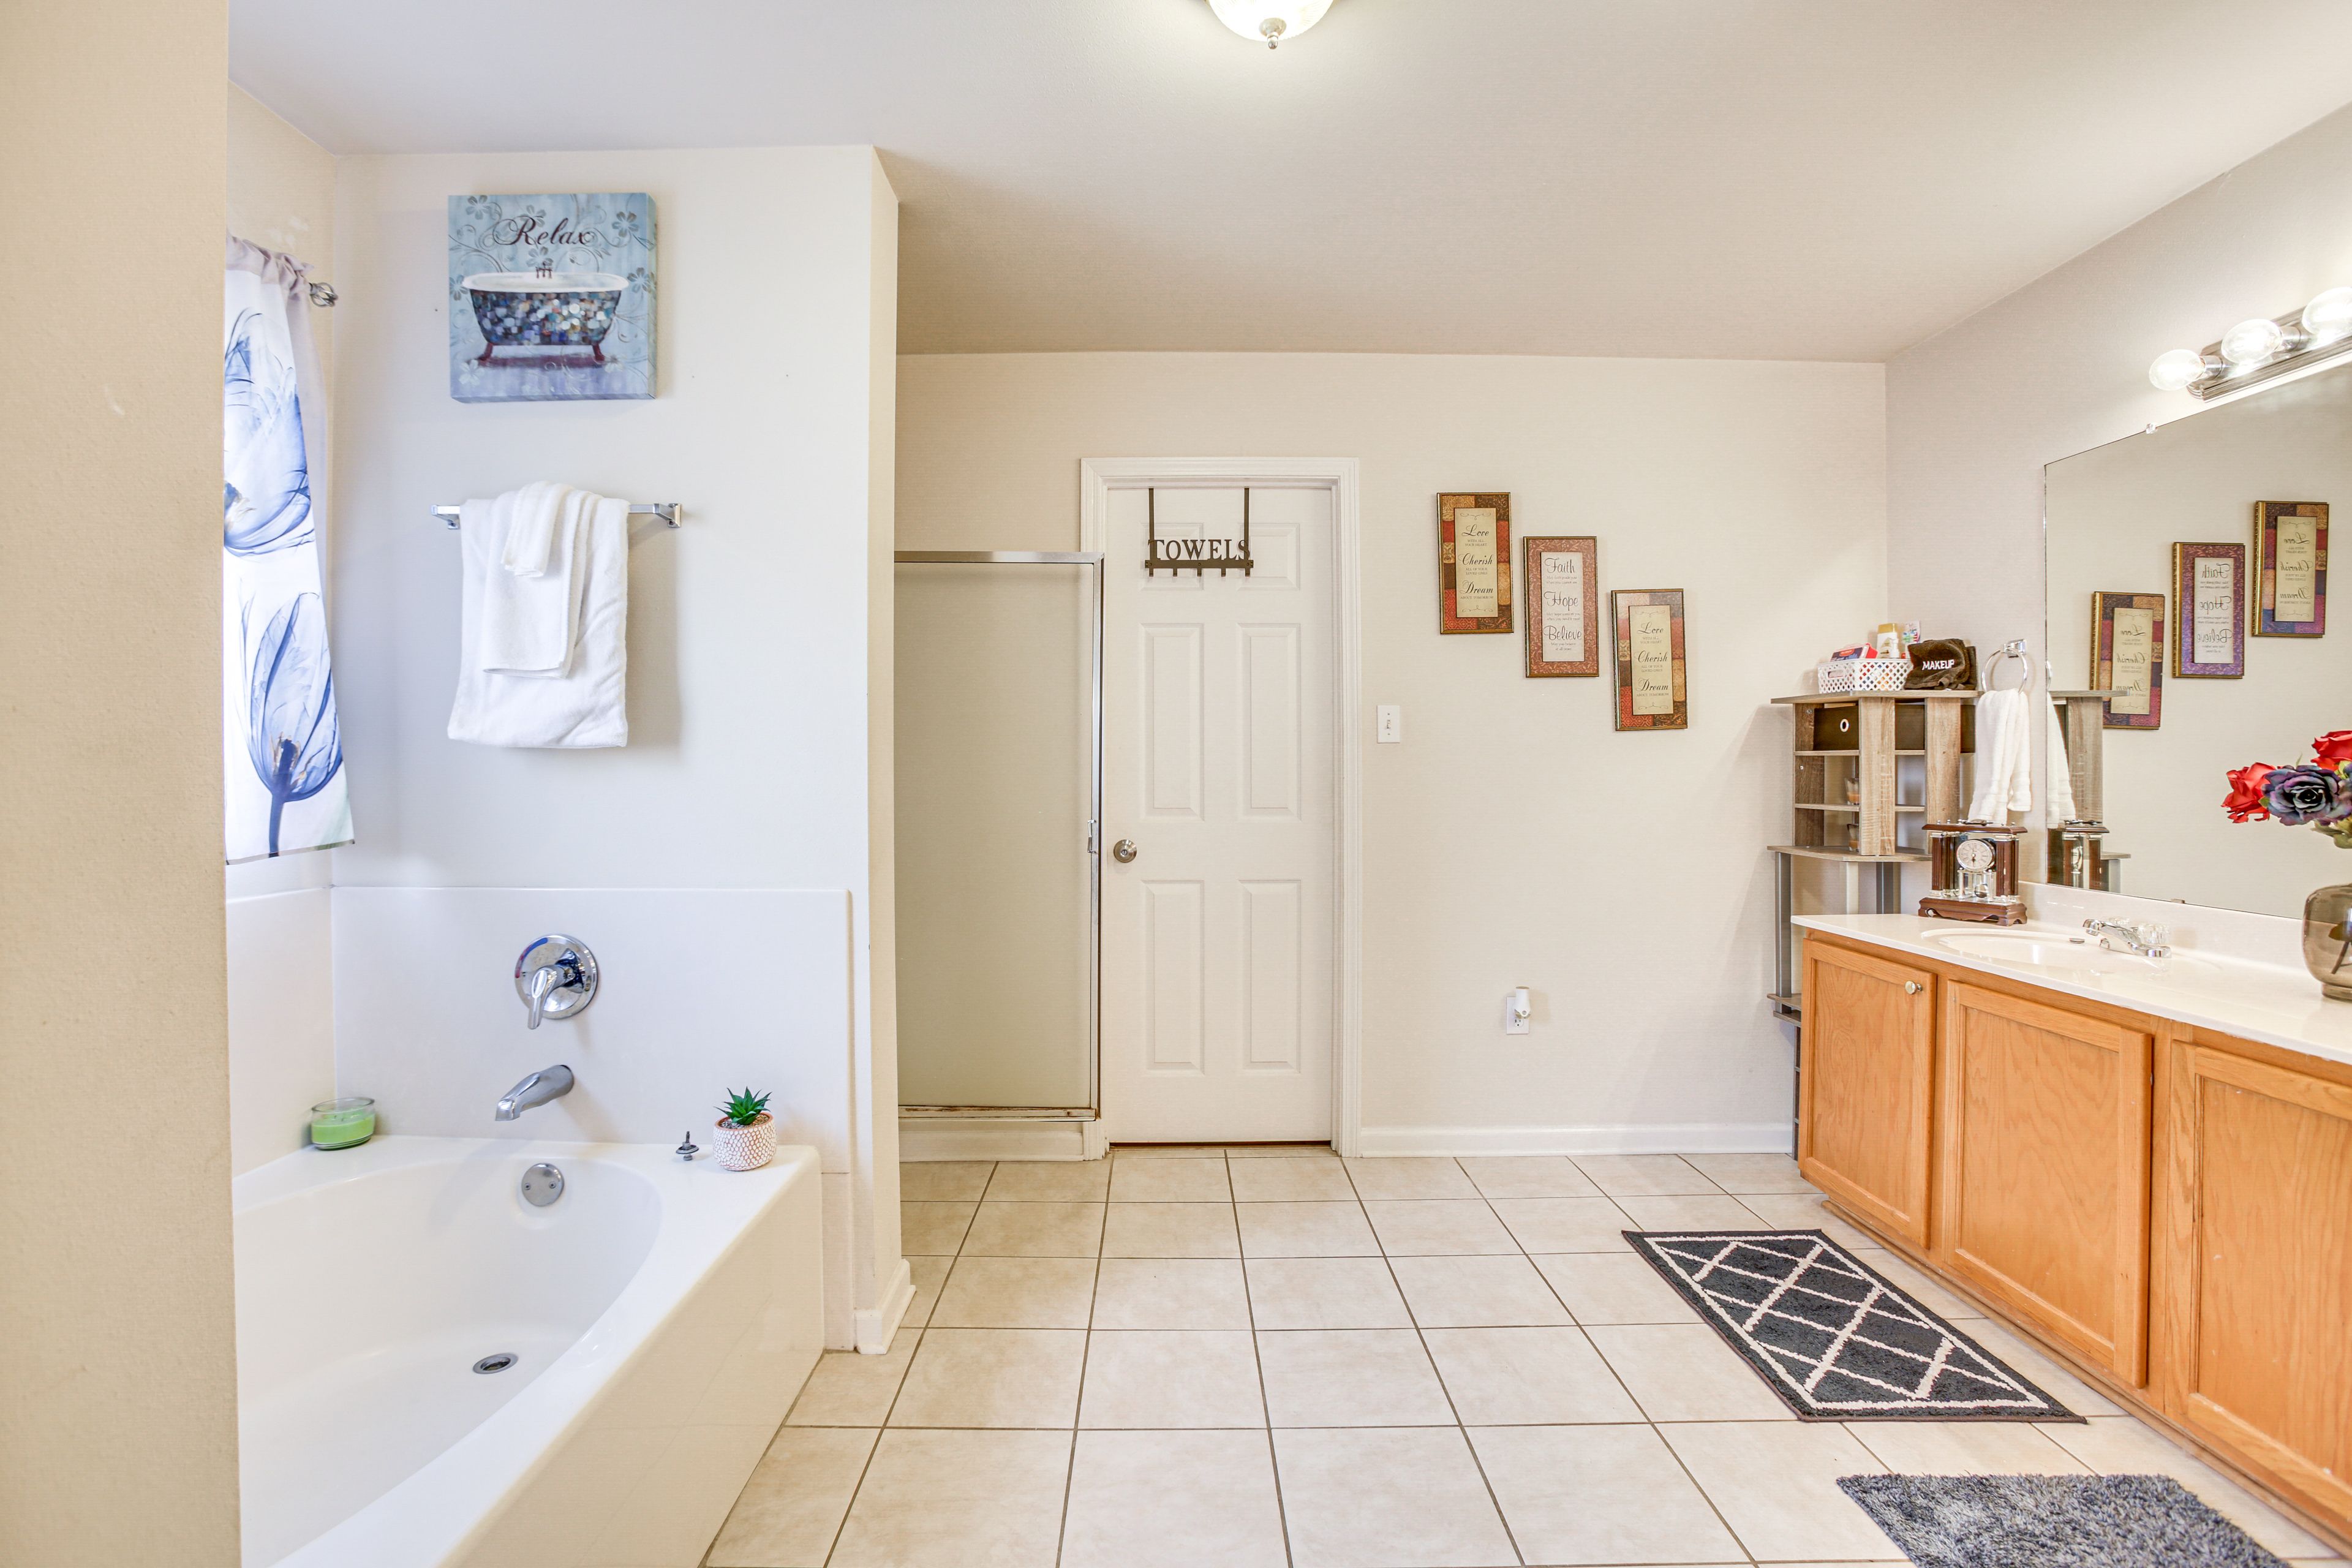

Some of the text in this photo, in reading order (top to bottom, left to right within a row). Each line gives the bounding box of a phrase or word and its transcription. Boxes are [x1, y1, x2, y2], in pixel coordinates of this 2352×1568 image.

[492, 216, 597, 246] Relax
[1461, 524, 1489, 537] Love
[1148, 539, 1250, 560] TOWELS
[1458, 552, 1494, 565] Cherish
[1544, 557, 1575, 573] Faith
[1460, 580, 1493, 594] Dream
[1544, 591, 1578, 611] Hope
[1544, 625, 1582, 641] Believe
[1637, 622, 1664, 635] Love
[1634, 650, 1668, 663] Cherish
[1921, 659, 1954, 671] MAKEUP
[1635, 677, 1668, 692] Dream
